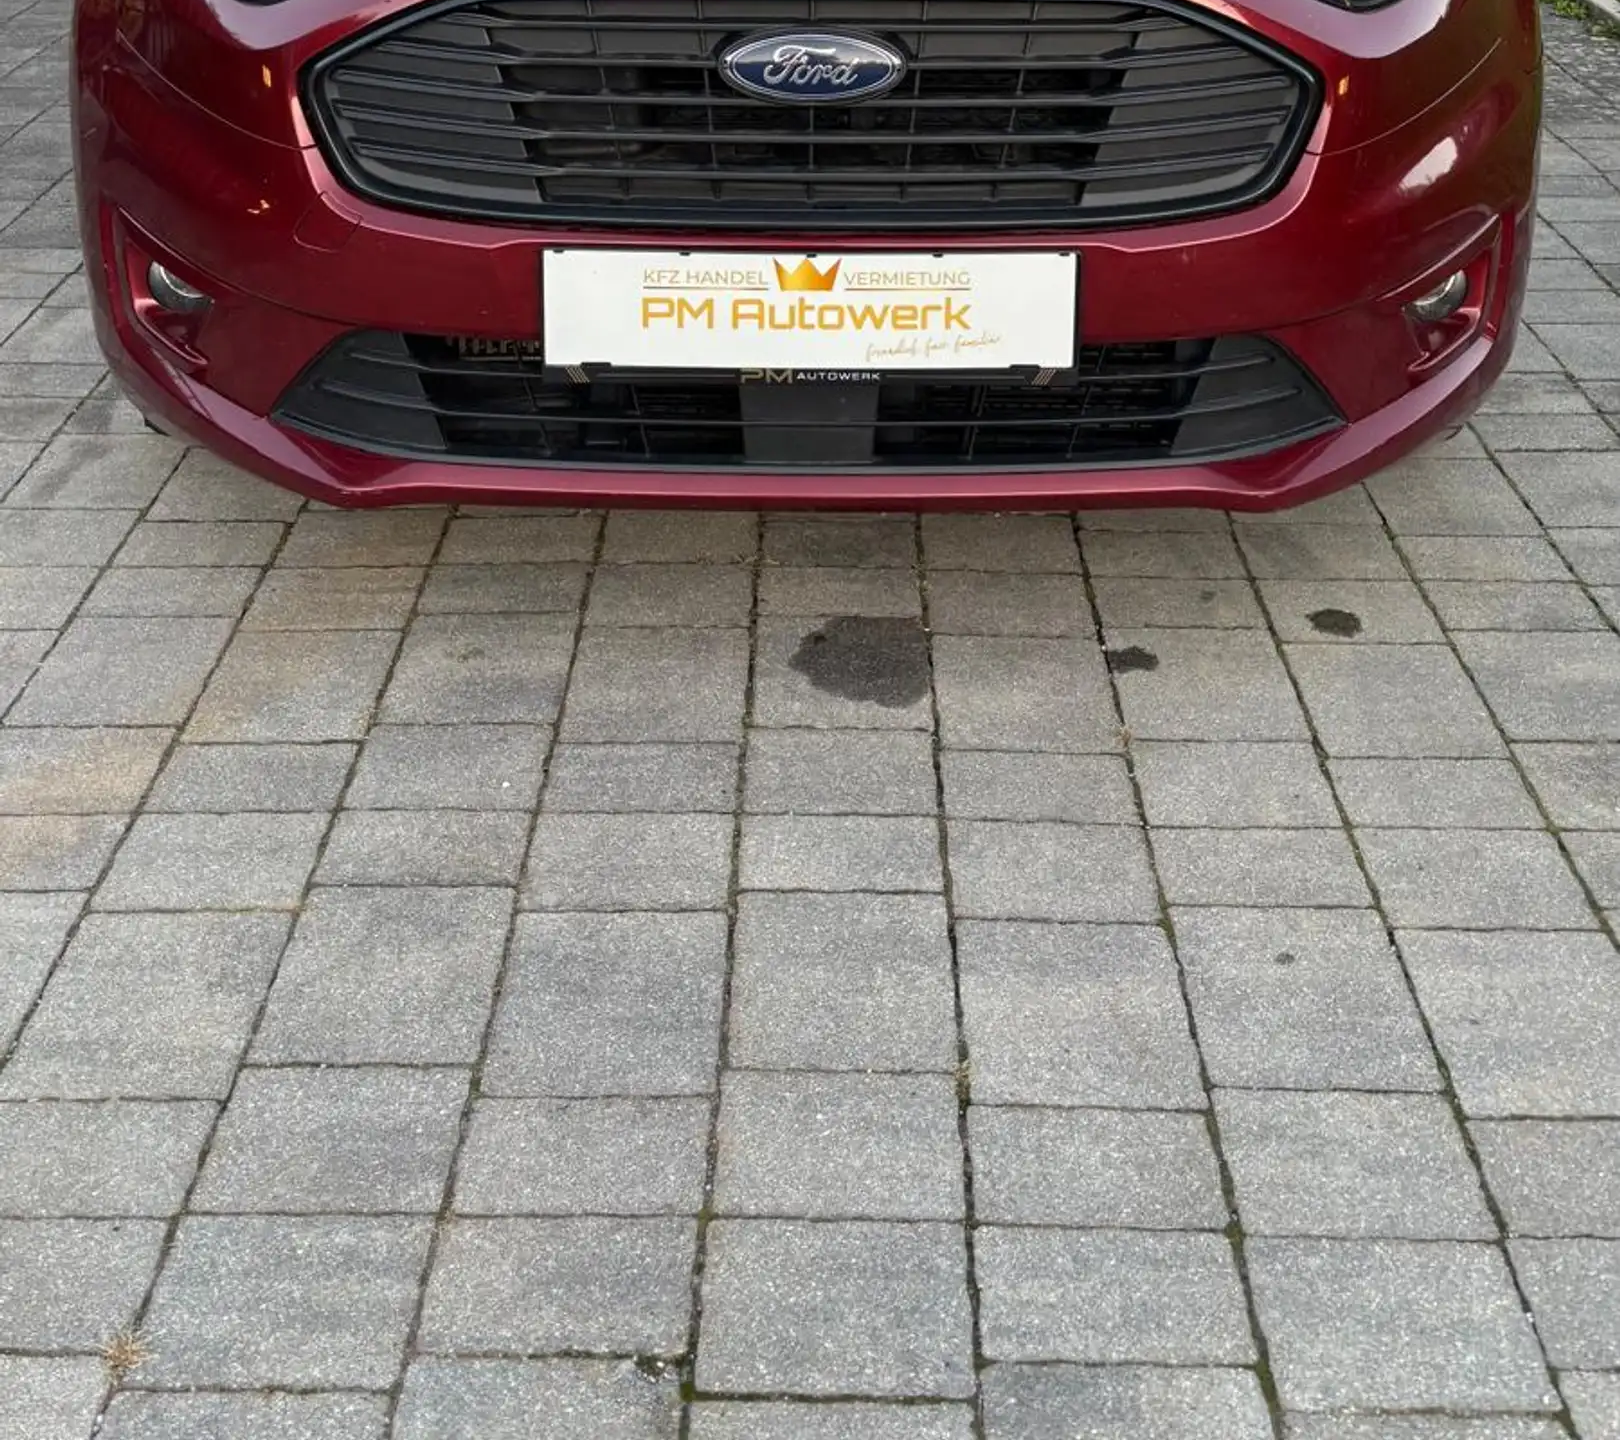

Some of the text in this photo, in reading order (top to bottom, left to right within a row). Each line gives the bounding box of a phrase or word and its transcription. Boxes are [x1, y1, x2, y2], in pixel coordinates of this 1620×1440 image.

[763, 44, 858, 85] Ford
[643, 269, 769, 286] KFZ HANDEL
[844, 271, 972, 286] VERMIETUNG
[641, 296, 972, 331] PM Autowerk
[739, 368, 881, 384] PM AUTOWERK
